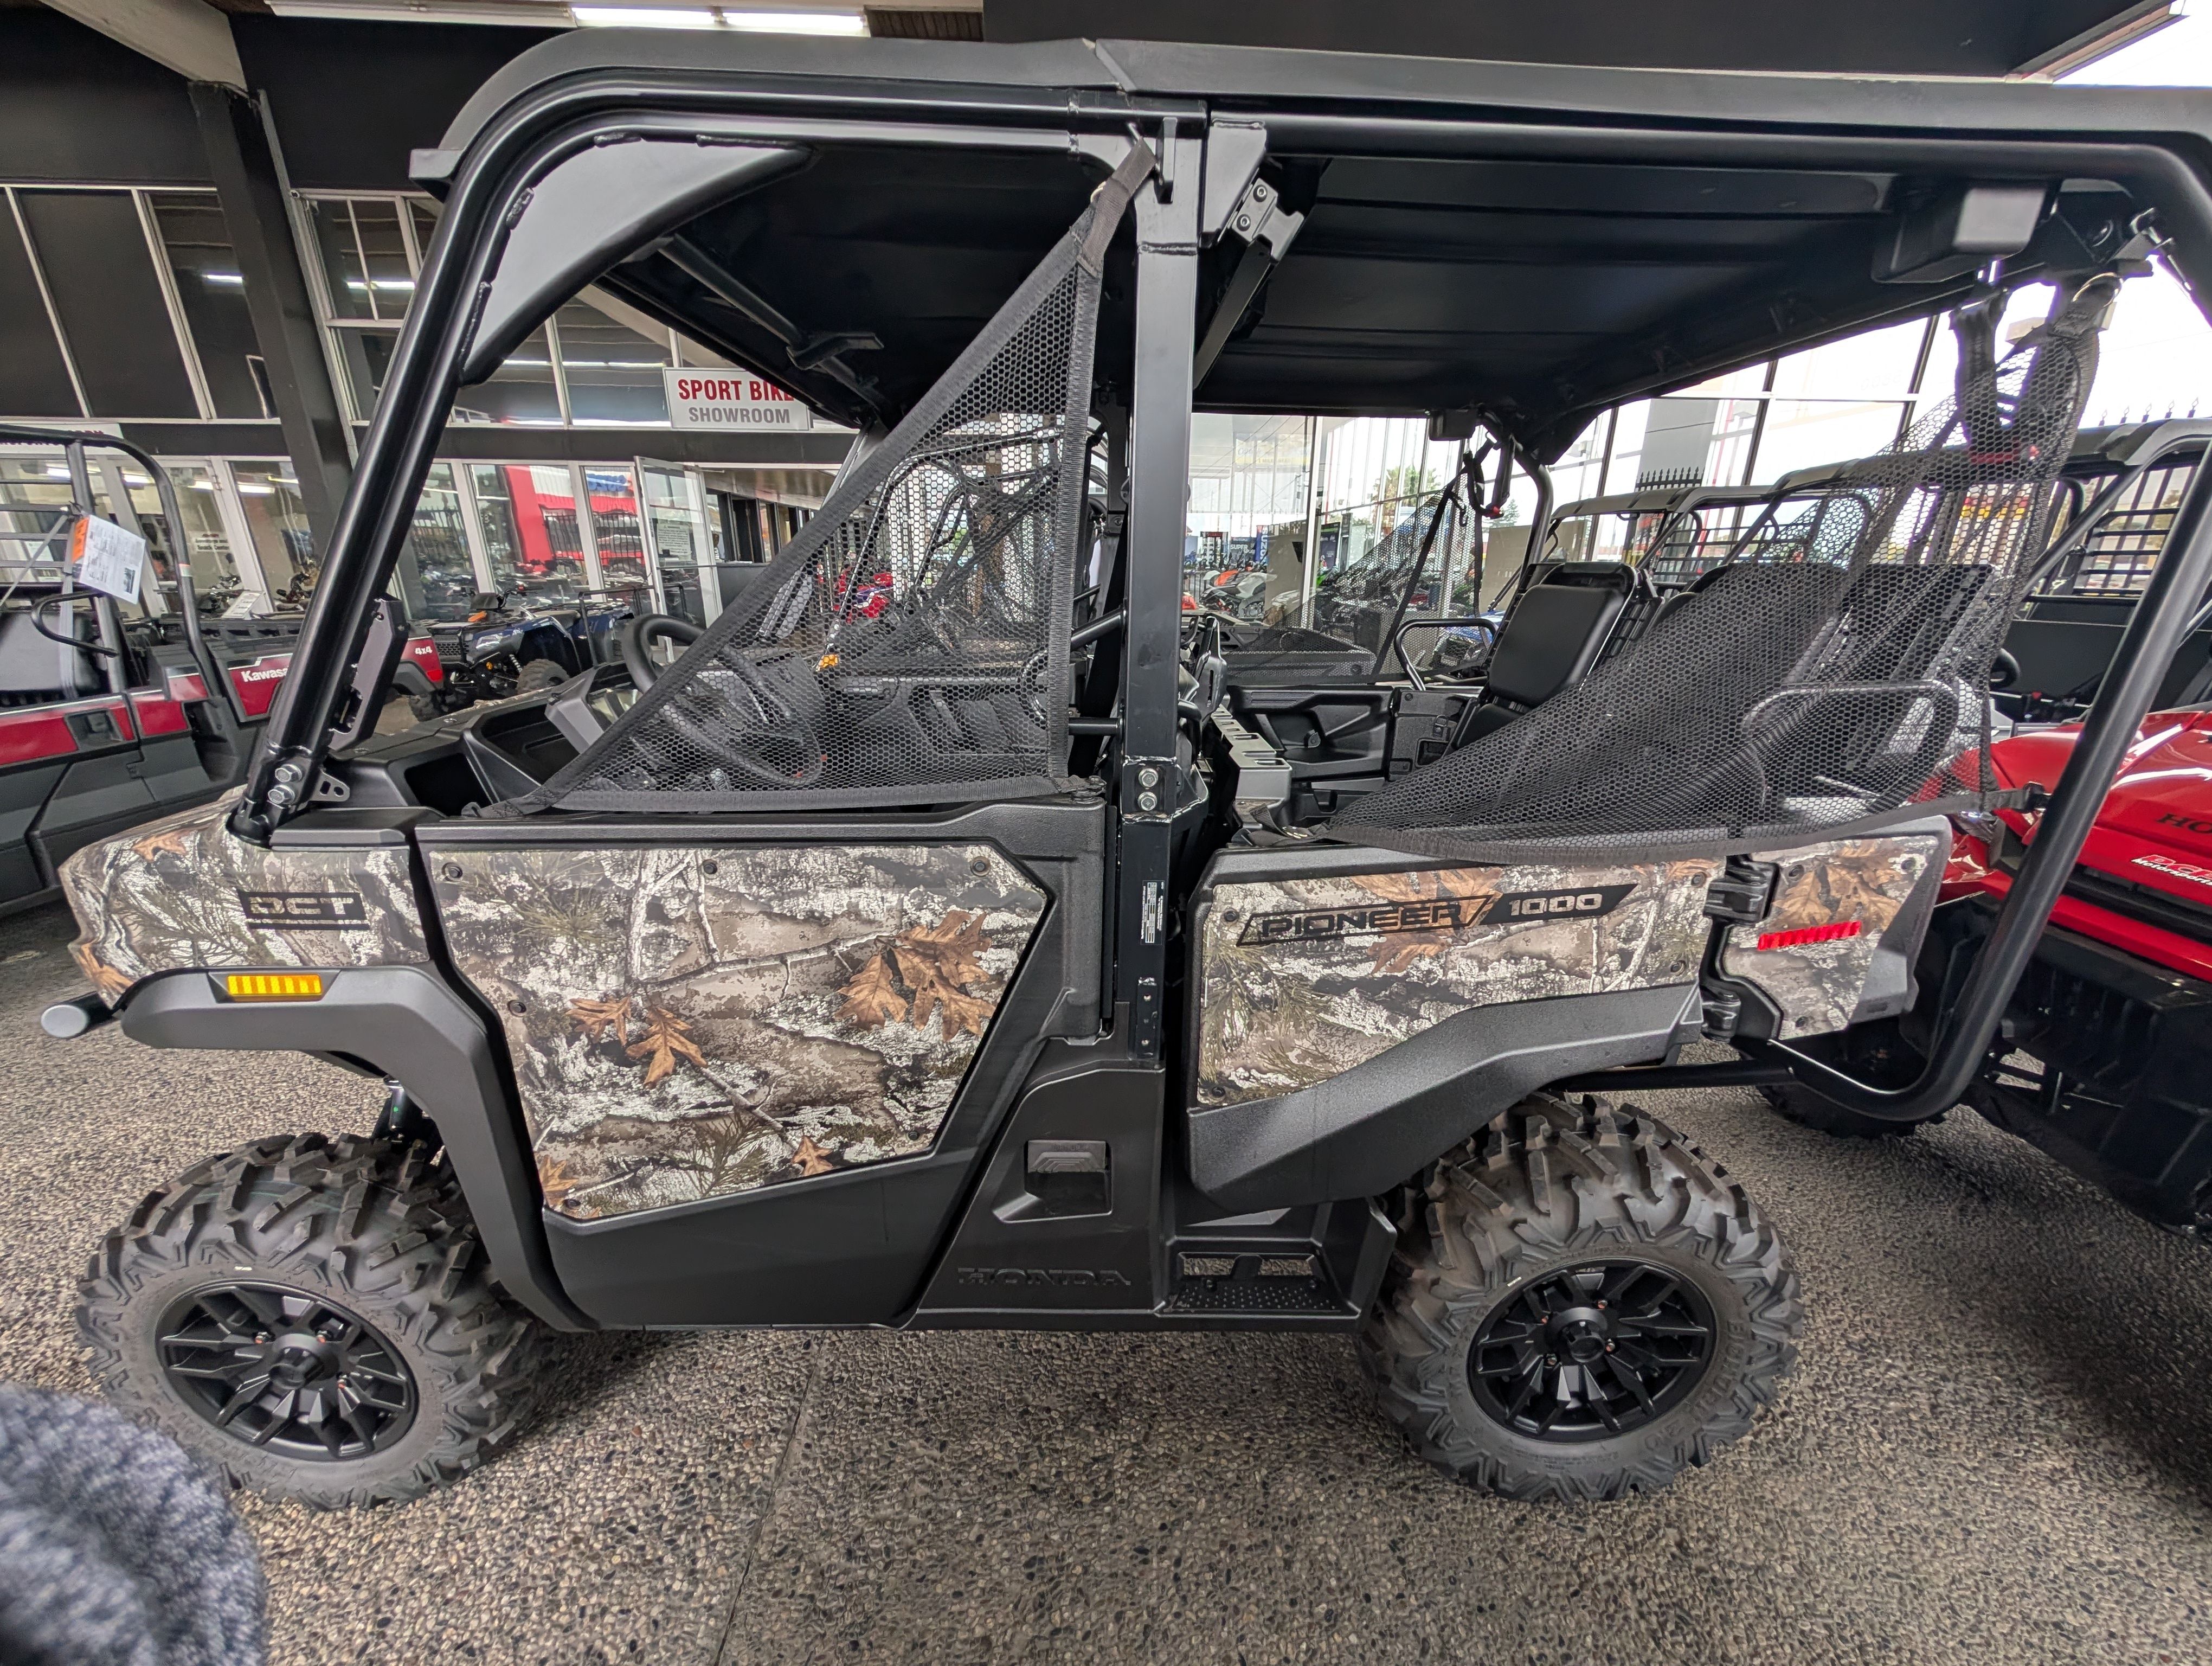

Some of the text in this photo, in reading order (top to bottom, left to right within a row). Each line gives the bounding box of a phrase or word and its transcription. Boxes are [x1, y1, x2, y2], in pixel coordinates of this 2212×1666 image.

[678, 379, 742, 400] SPORT
[689, 407, 790, 424] SHOWROOM
[415, 646, 432, 655] 4x4
[241, 667, 288, 682] Kawasa
[248, 897, 354, 915] DCT
[1262, 893, 1603, 937] PIONEER 1000
[958, 1268, 1131, 1286] HONDA
